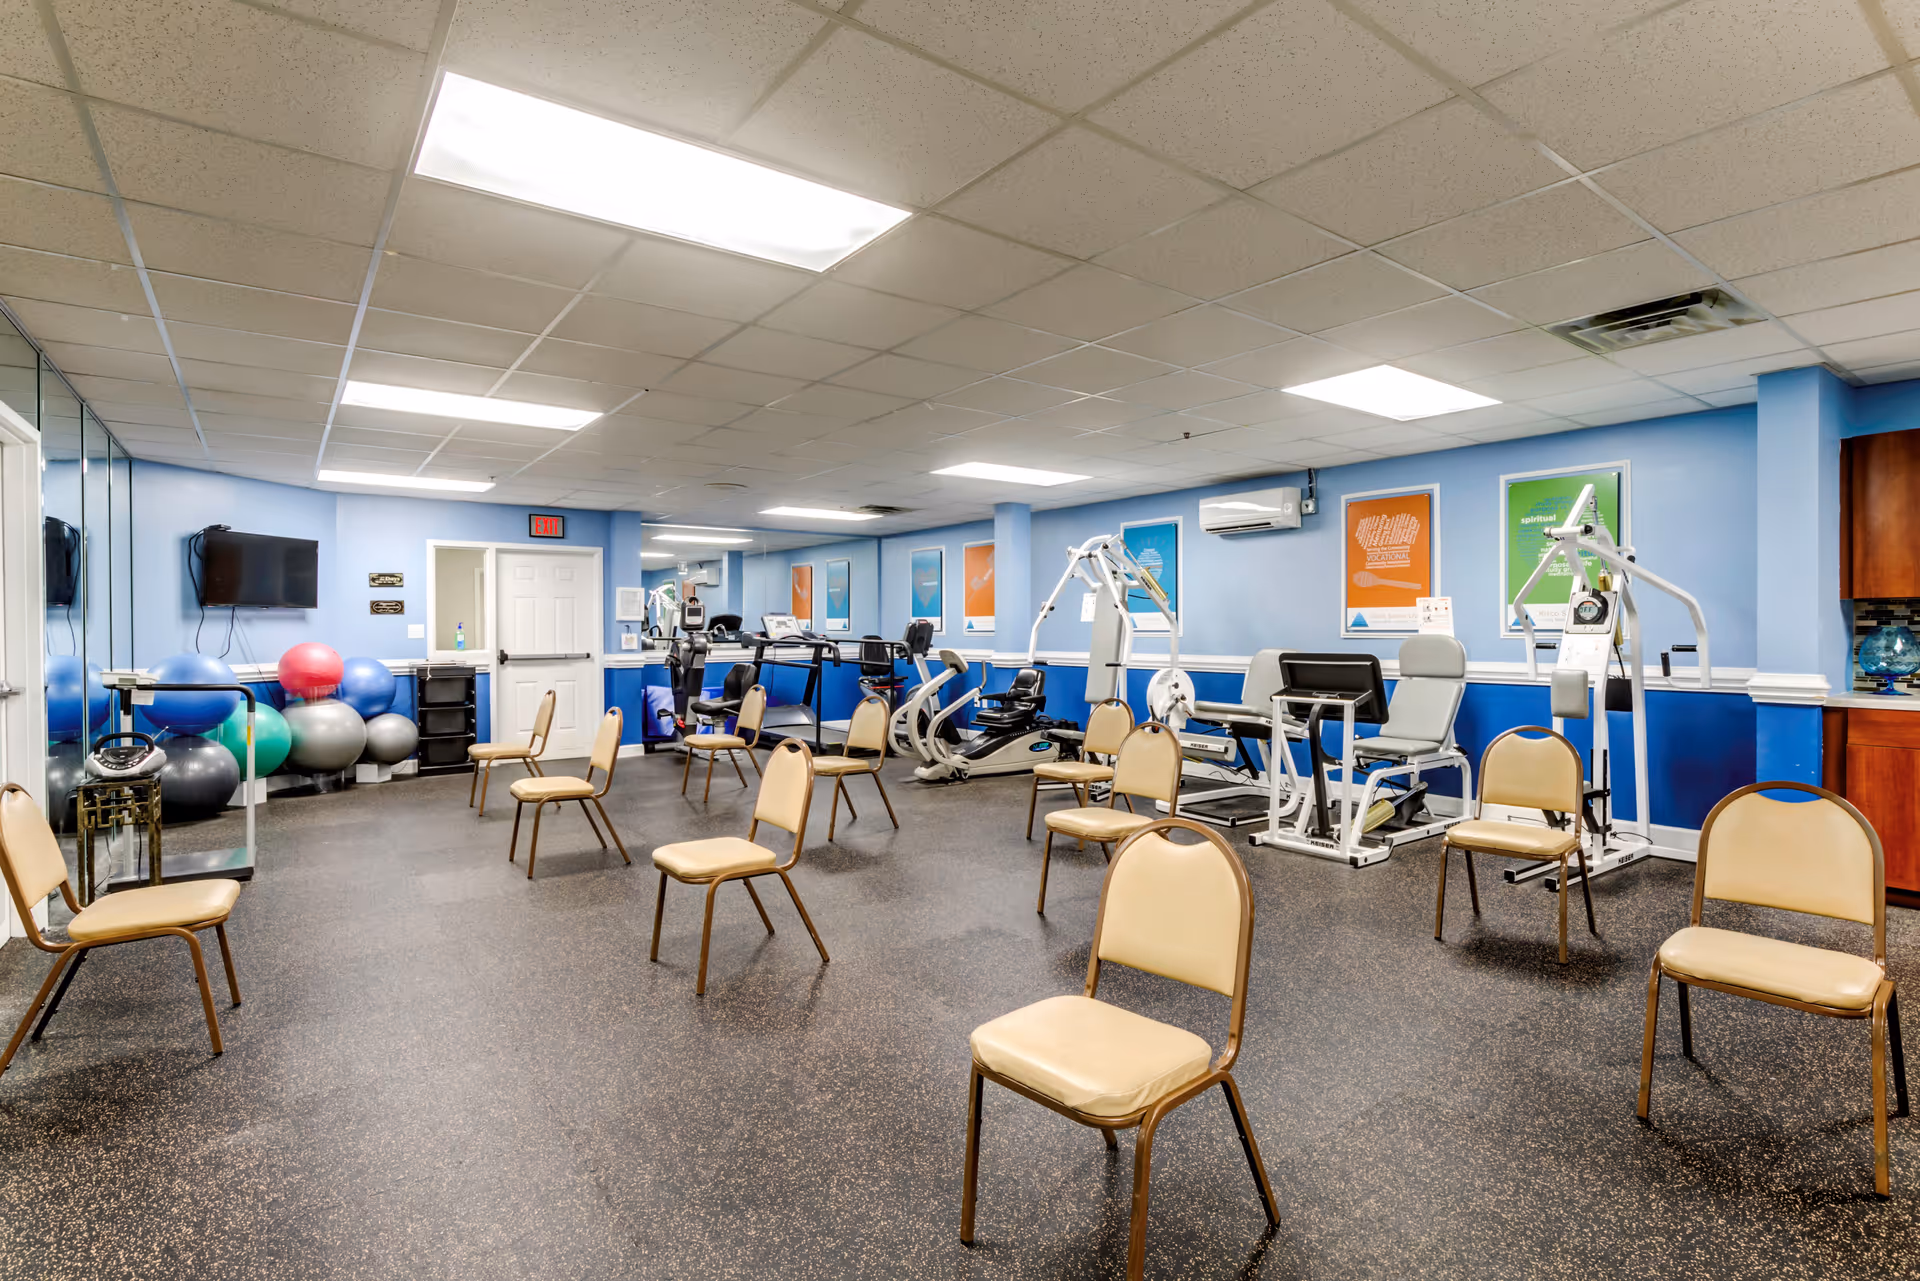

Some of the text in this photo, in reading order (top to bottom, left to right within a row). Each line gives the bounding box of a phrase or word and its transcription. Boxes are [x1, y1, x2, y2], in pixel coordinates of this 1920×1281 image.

[1521, 514, 1556, 524] spiritual
[535, 517, 559, 535] EXIT
[1372, 514, 1388, 546] Mentoring
[1367, 552, 1410, 561] VOCATIONAL
[1310, 840, 1334, 849] KEISER
